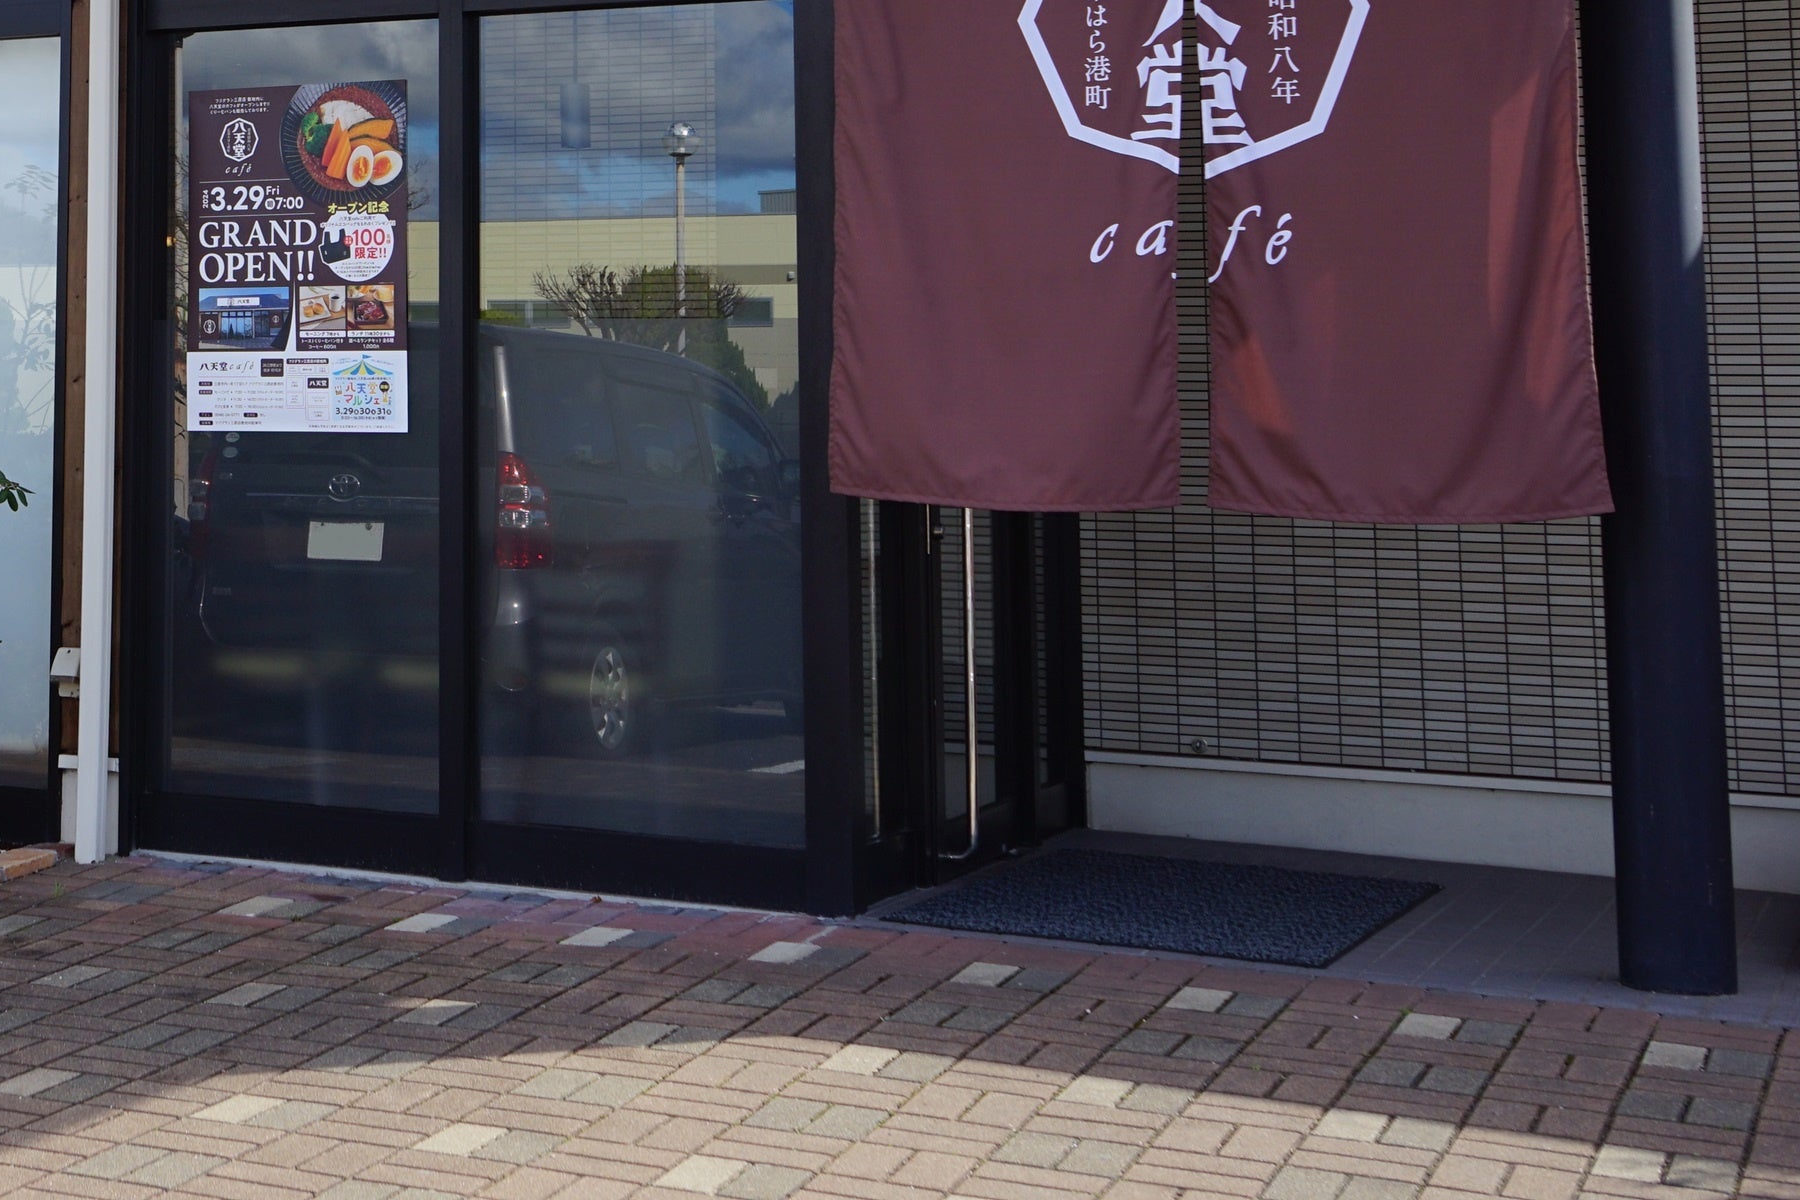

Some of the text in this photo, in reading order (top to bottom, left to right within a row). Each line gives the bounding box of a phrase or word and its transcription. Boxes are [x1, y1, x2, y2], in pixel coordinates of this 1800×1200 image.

[232, 122, 247, 158] 八天堂
[210, 185, 265, 211] 3.29
[266, 185, 280, 195] Fri
[327, 201, 390, 214] オープン記念
[199, 219, 317, 248] GRAND
[355, 247, 387, 259] 限定!!
[199, 250, 314, 283] OPEN!!
[199, 362, 228, 371] 八天堂
[346, 381, 378, 395] 八天堂
[343, 394, 380, 406] マルシェ
